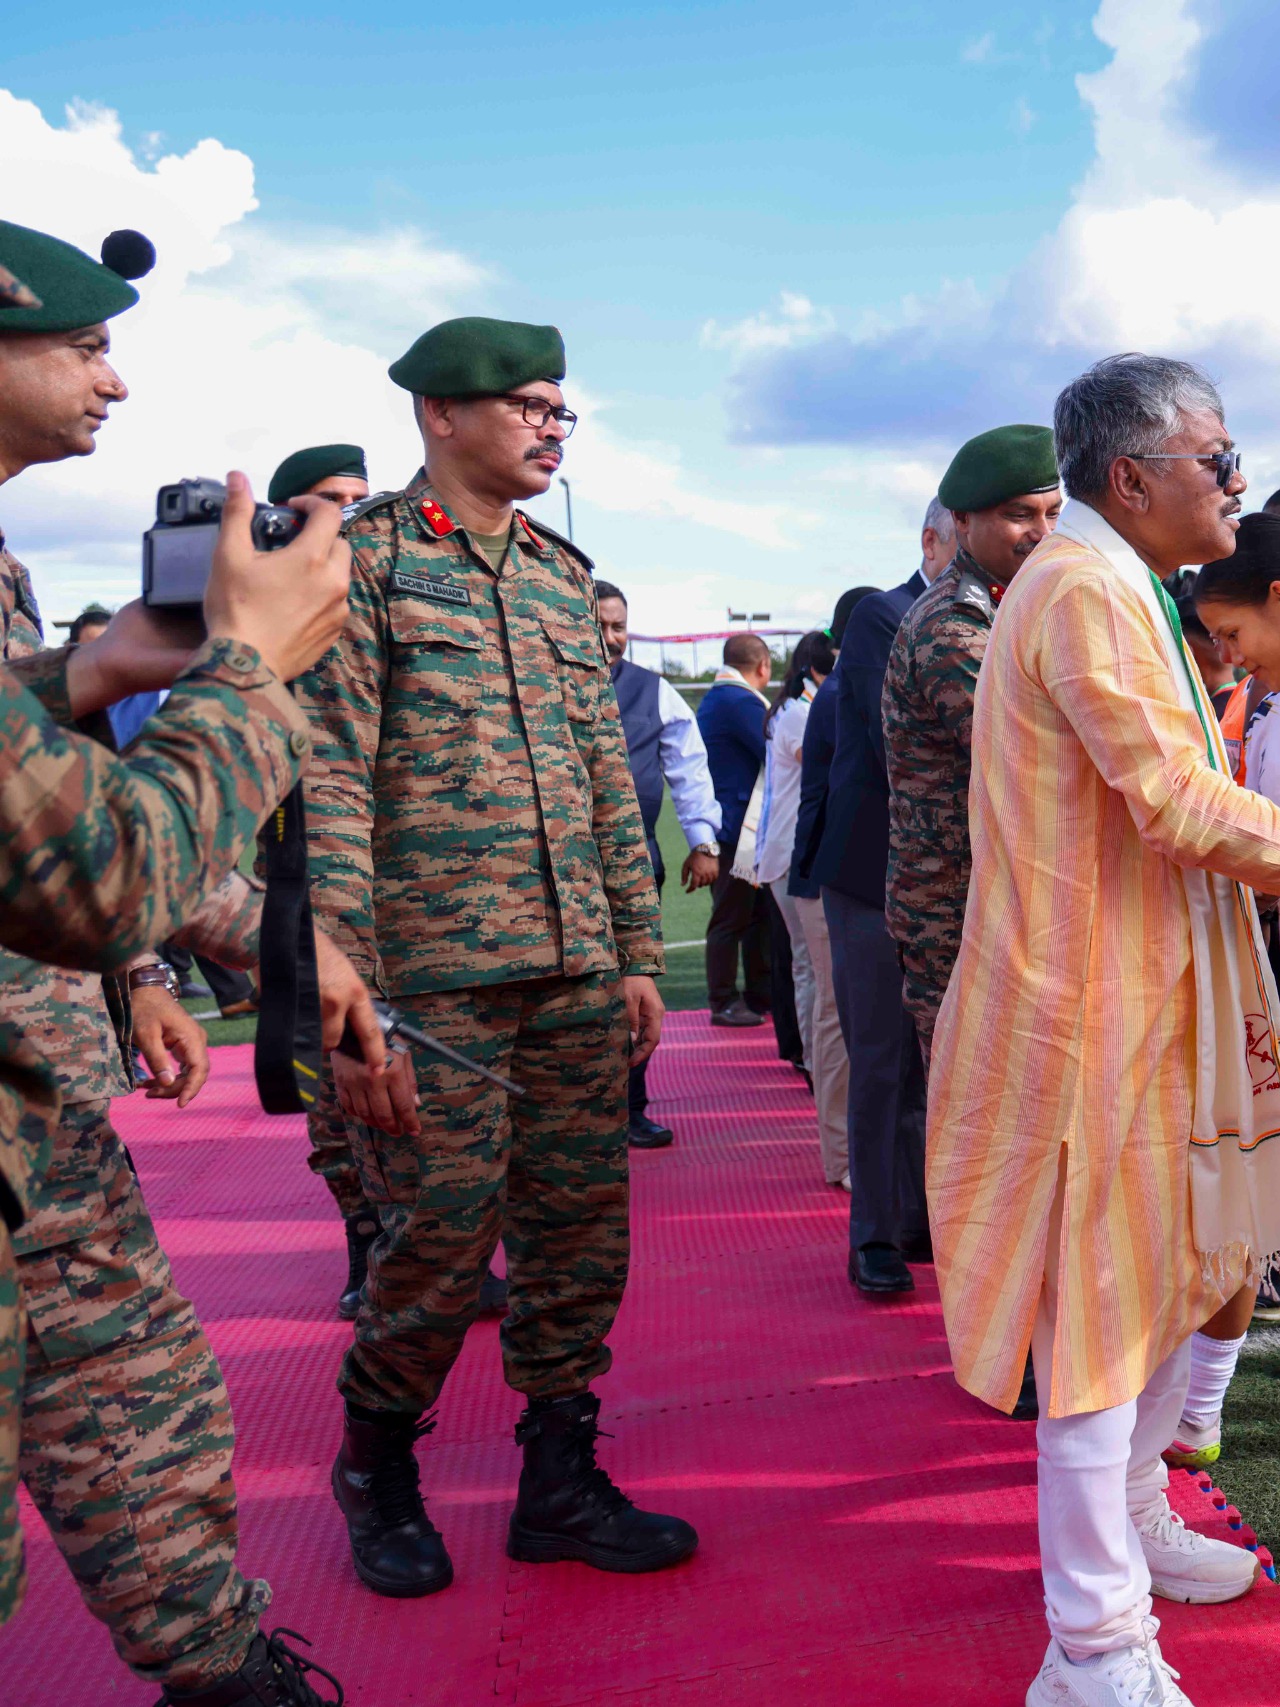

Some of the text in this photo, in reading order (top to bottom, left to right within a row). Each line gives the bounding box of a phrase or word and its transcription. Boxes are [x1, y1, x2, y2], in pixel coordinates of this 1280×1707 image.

[398, 576, 466, 599] SACHIN S MAHADIK
